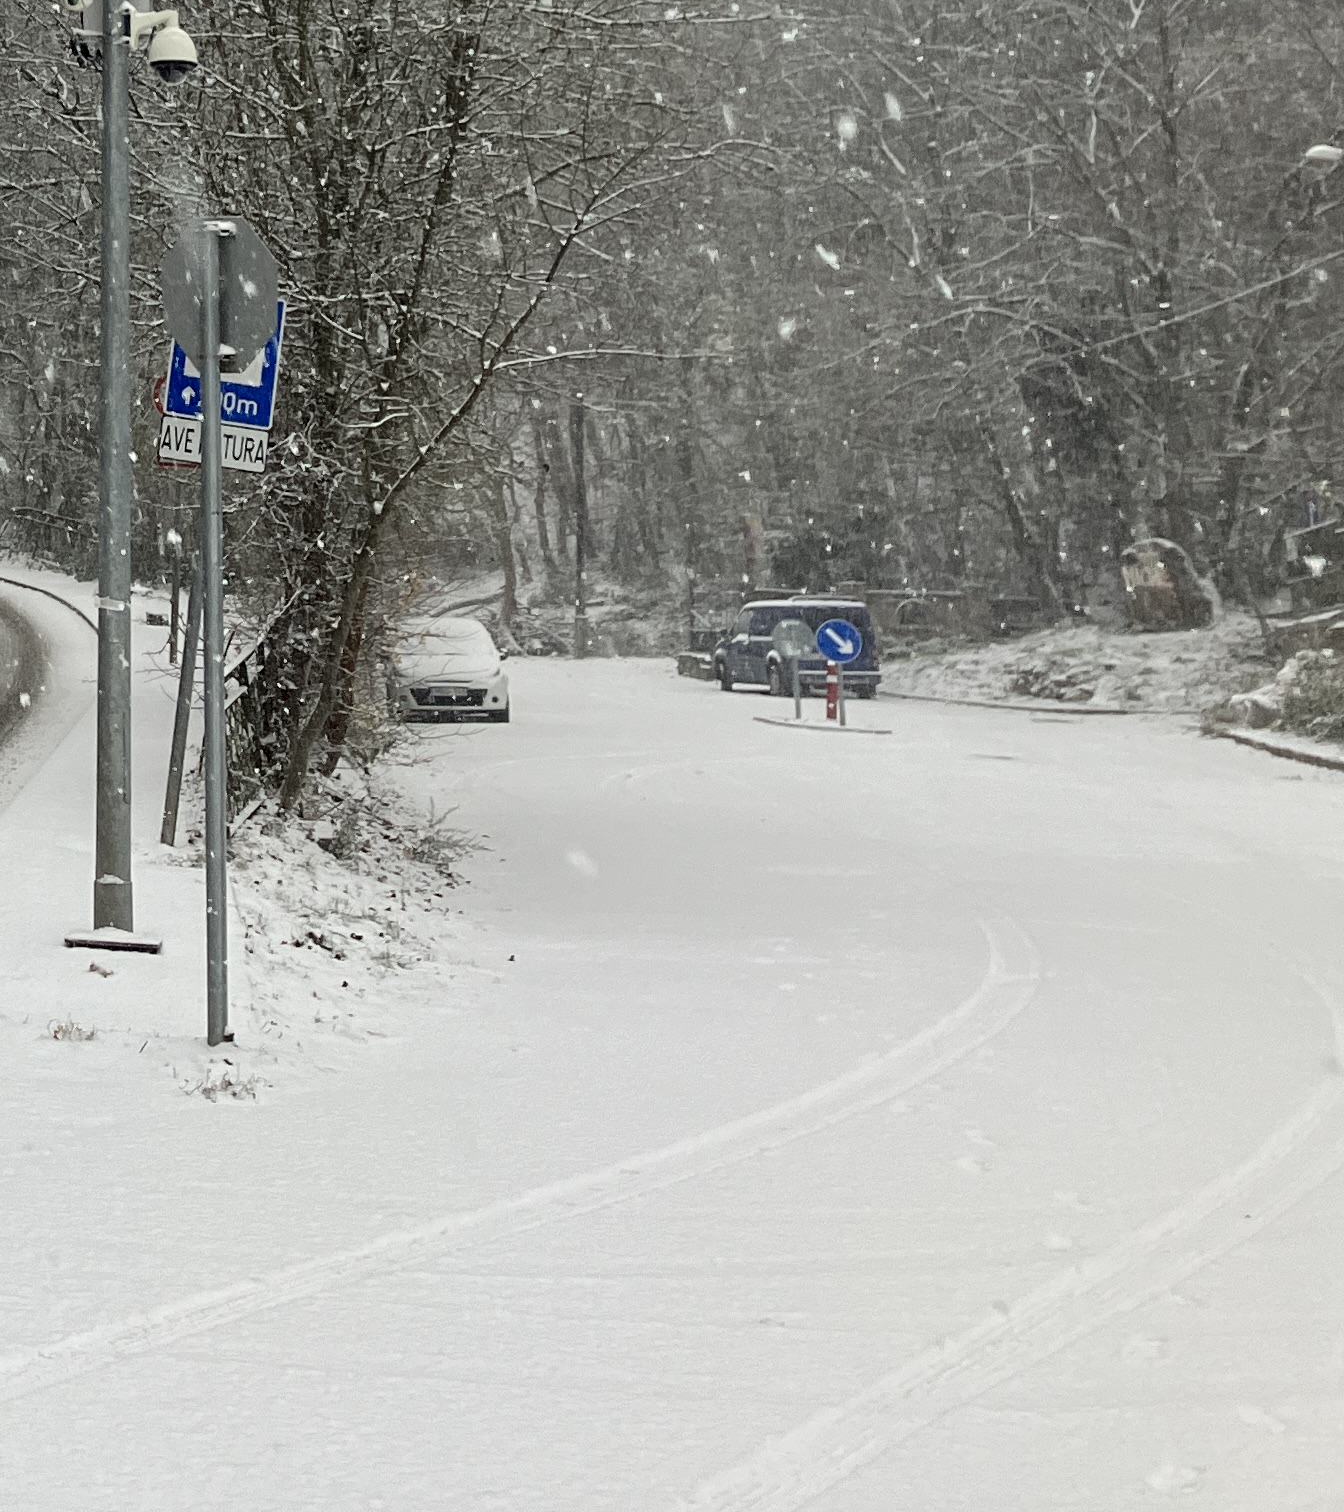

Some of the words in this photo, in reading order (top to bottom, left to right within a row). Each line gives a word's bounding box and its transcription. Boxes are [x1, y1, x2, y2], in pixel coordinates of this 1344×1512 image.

[198, 390, 258, 416] 0m
[161, 424, 195, 454] AVE
[199, 430, 265, 464] TURA
